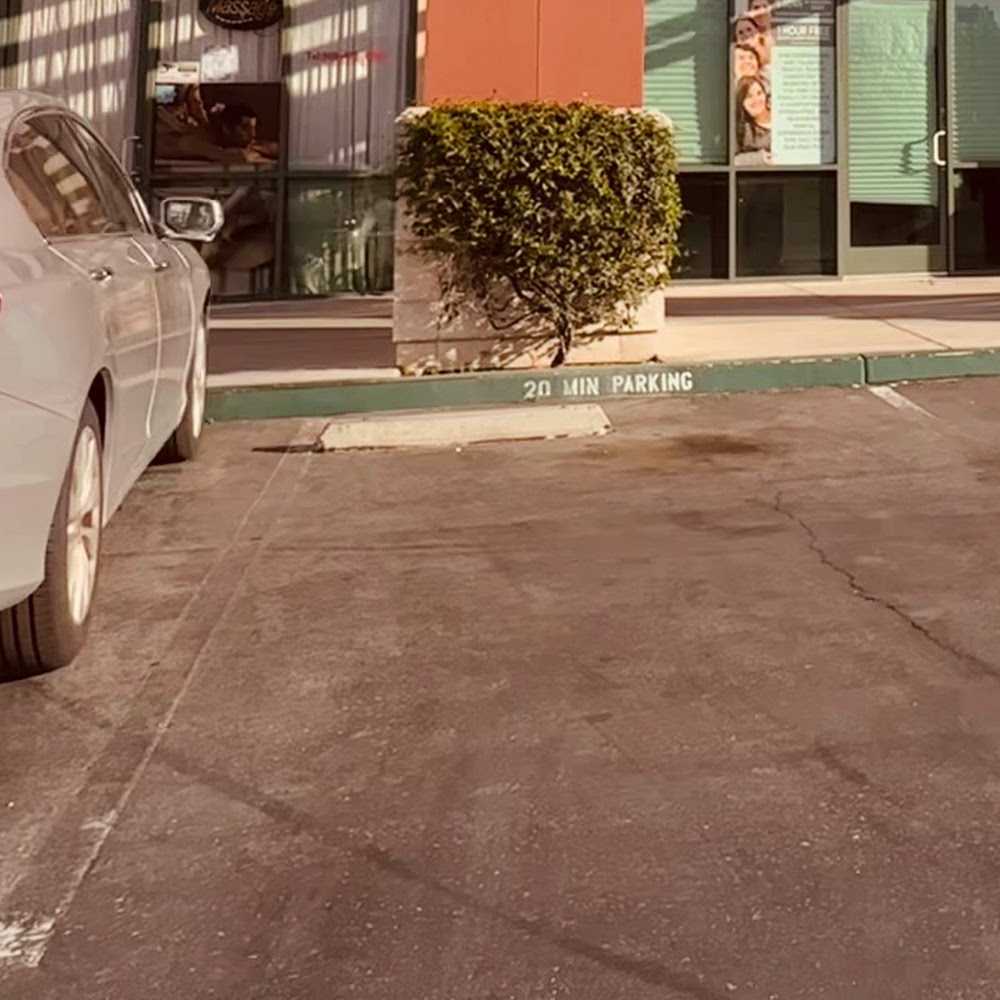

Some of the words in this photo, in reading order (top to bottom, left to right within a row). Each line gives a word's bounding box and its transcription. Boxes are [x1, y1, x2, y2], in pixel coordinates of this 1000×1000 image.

[783, 25, 807, 37] HOUR
[523, 380, 551, 399] 20
[563, 377, 599, 396] MIN
[612, 371, 693, 393] PARKING
